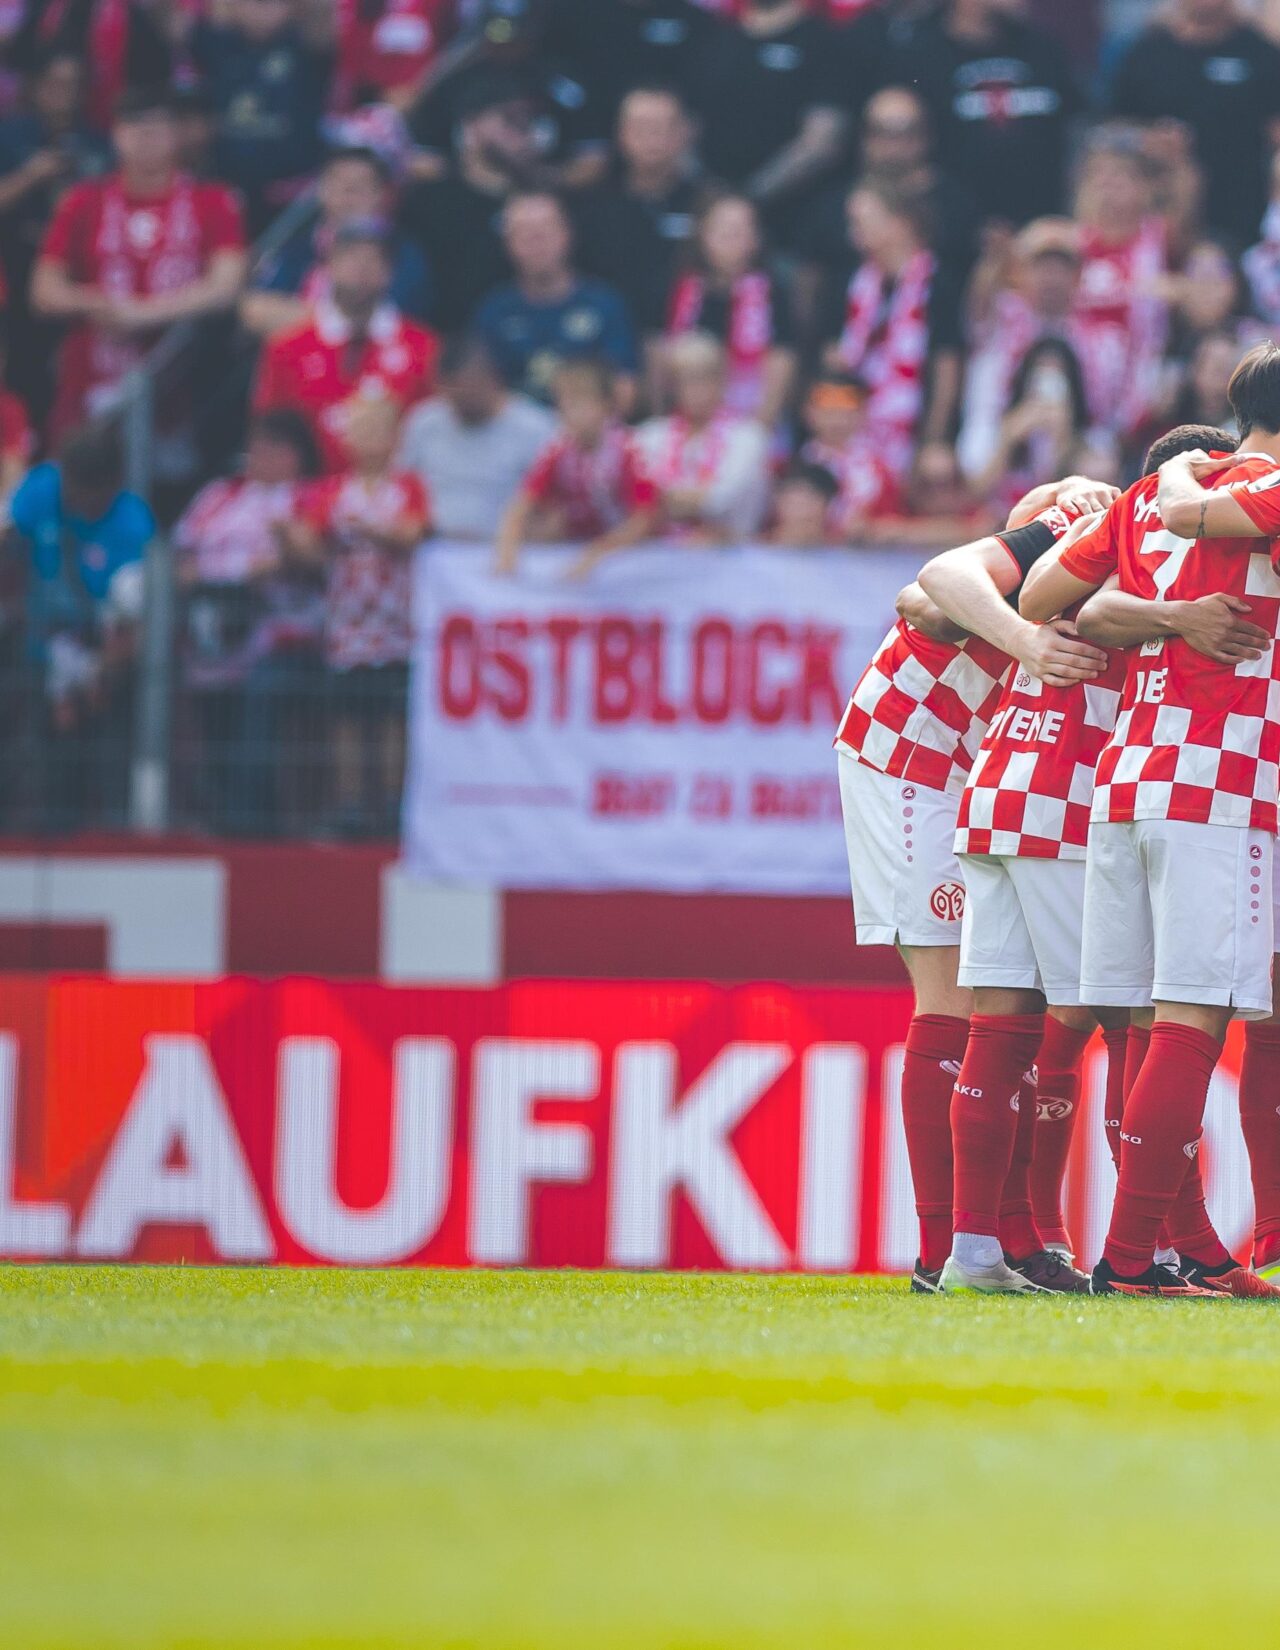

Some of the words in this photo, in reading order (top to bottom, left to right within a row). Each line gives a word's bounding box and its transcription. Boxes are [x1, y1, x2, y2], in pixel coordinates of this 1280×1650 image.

[1139, 529, 1198, 602] 7
[440, 613, 842, 728] OSTBLOCK
[952, 1083, 984, 1099] AKO
